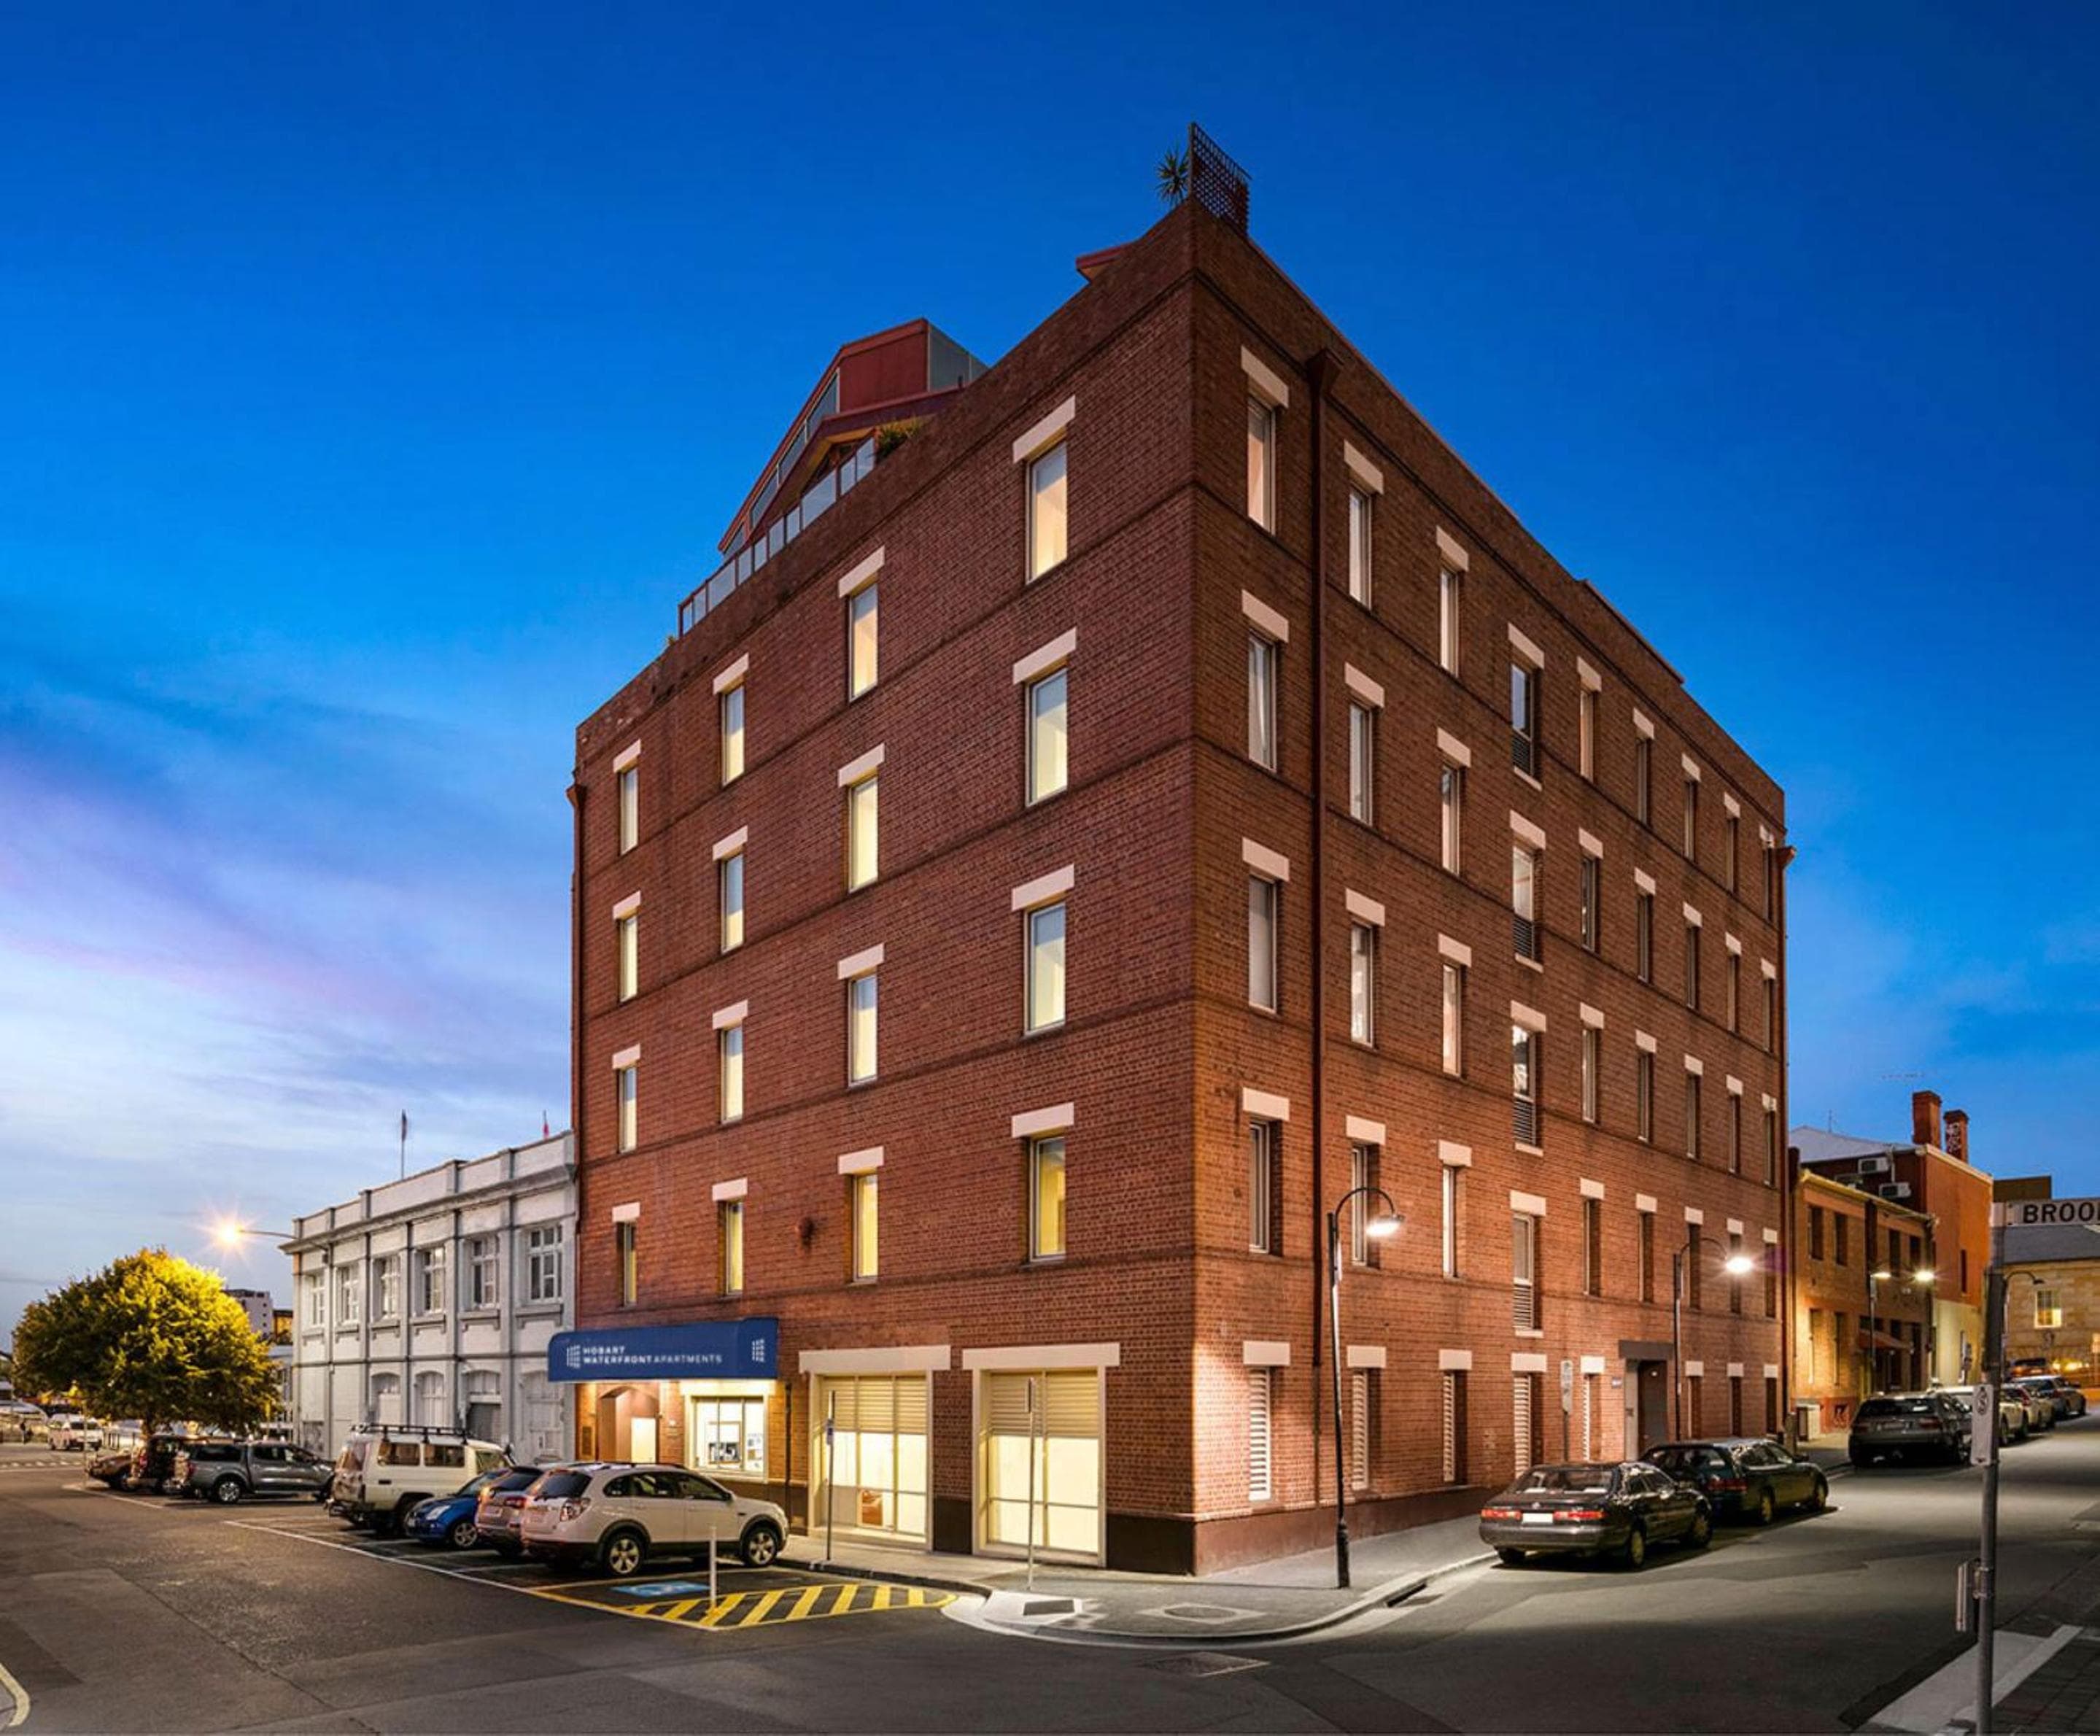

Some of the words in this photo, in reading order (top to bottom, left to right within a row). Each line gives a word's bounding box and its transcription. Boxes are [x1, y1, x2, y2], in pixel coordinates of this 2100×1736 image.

[2023, 1202, 2100, 1223] BROO
[583, 1346, 625, 1355] HOBART
[583, 1355, 651, 1364] WATERFRONT
[653, 1355, 723, 1364] APARTMENTS
